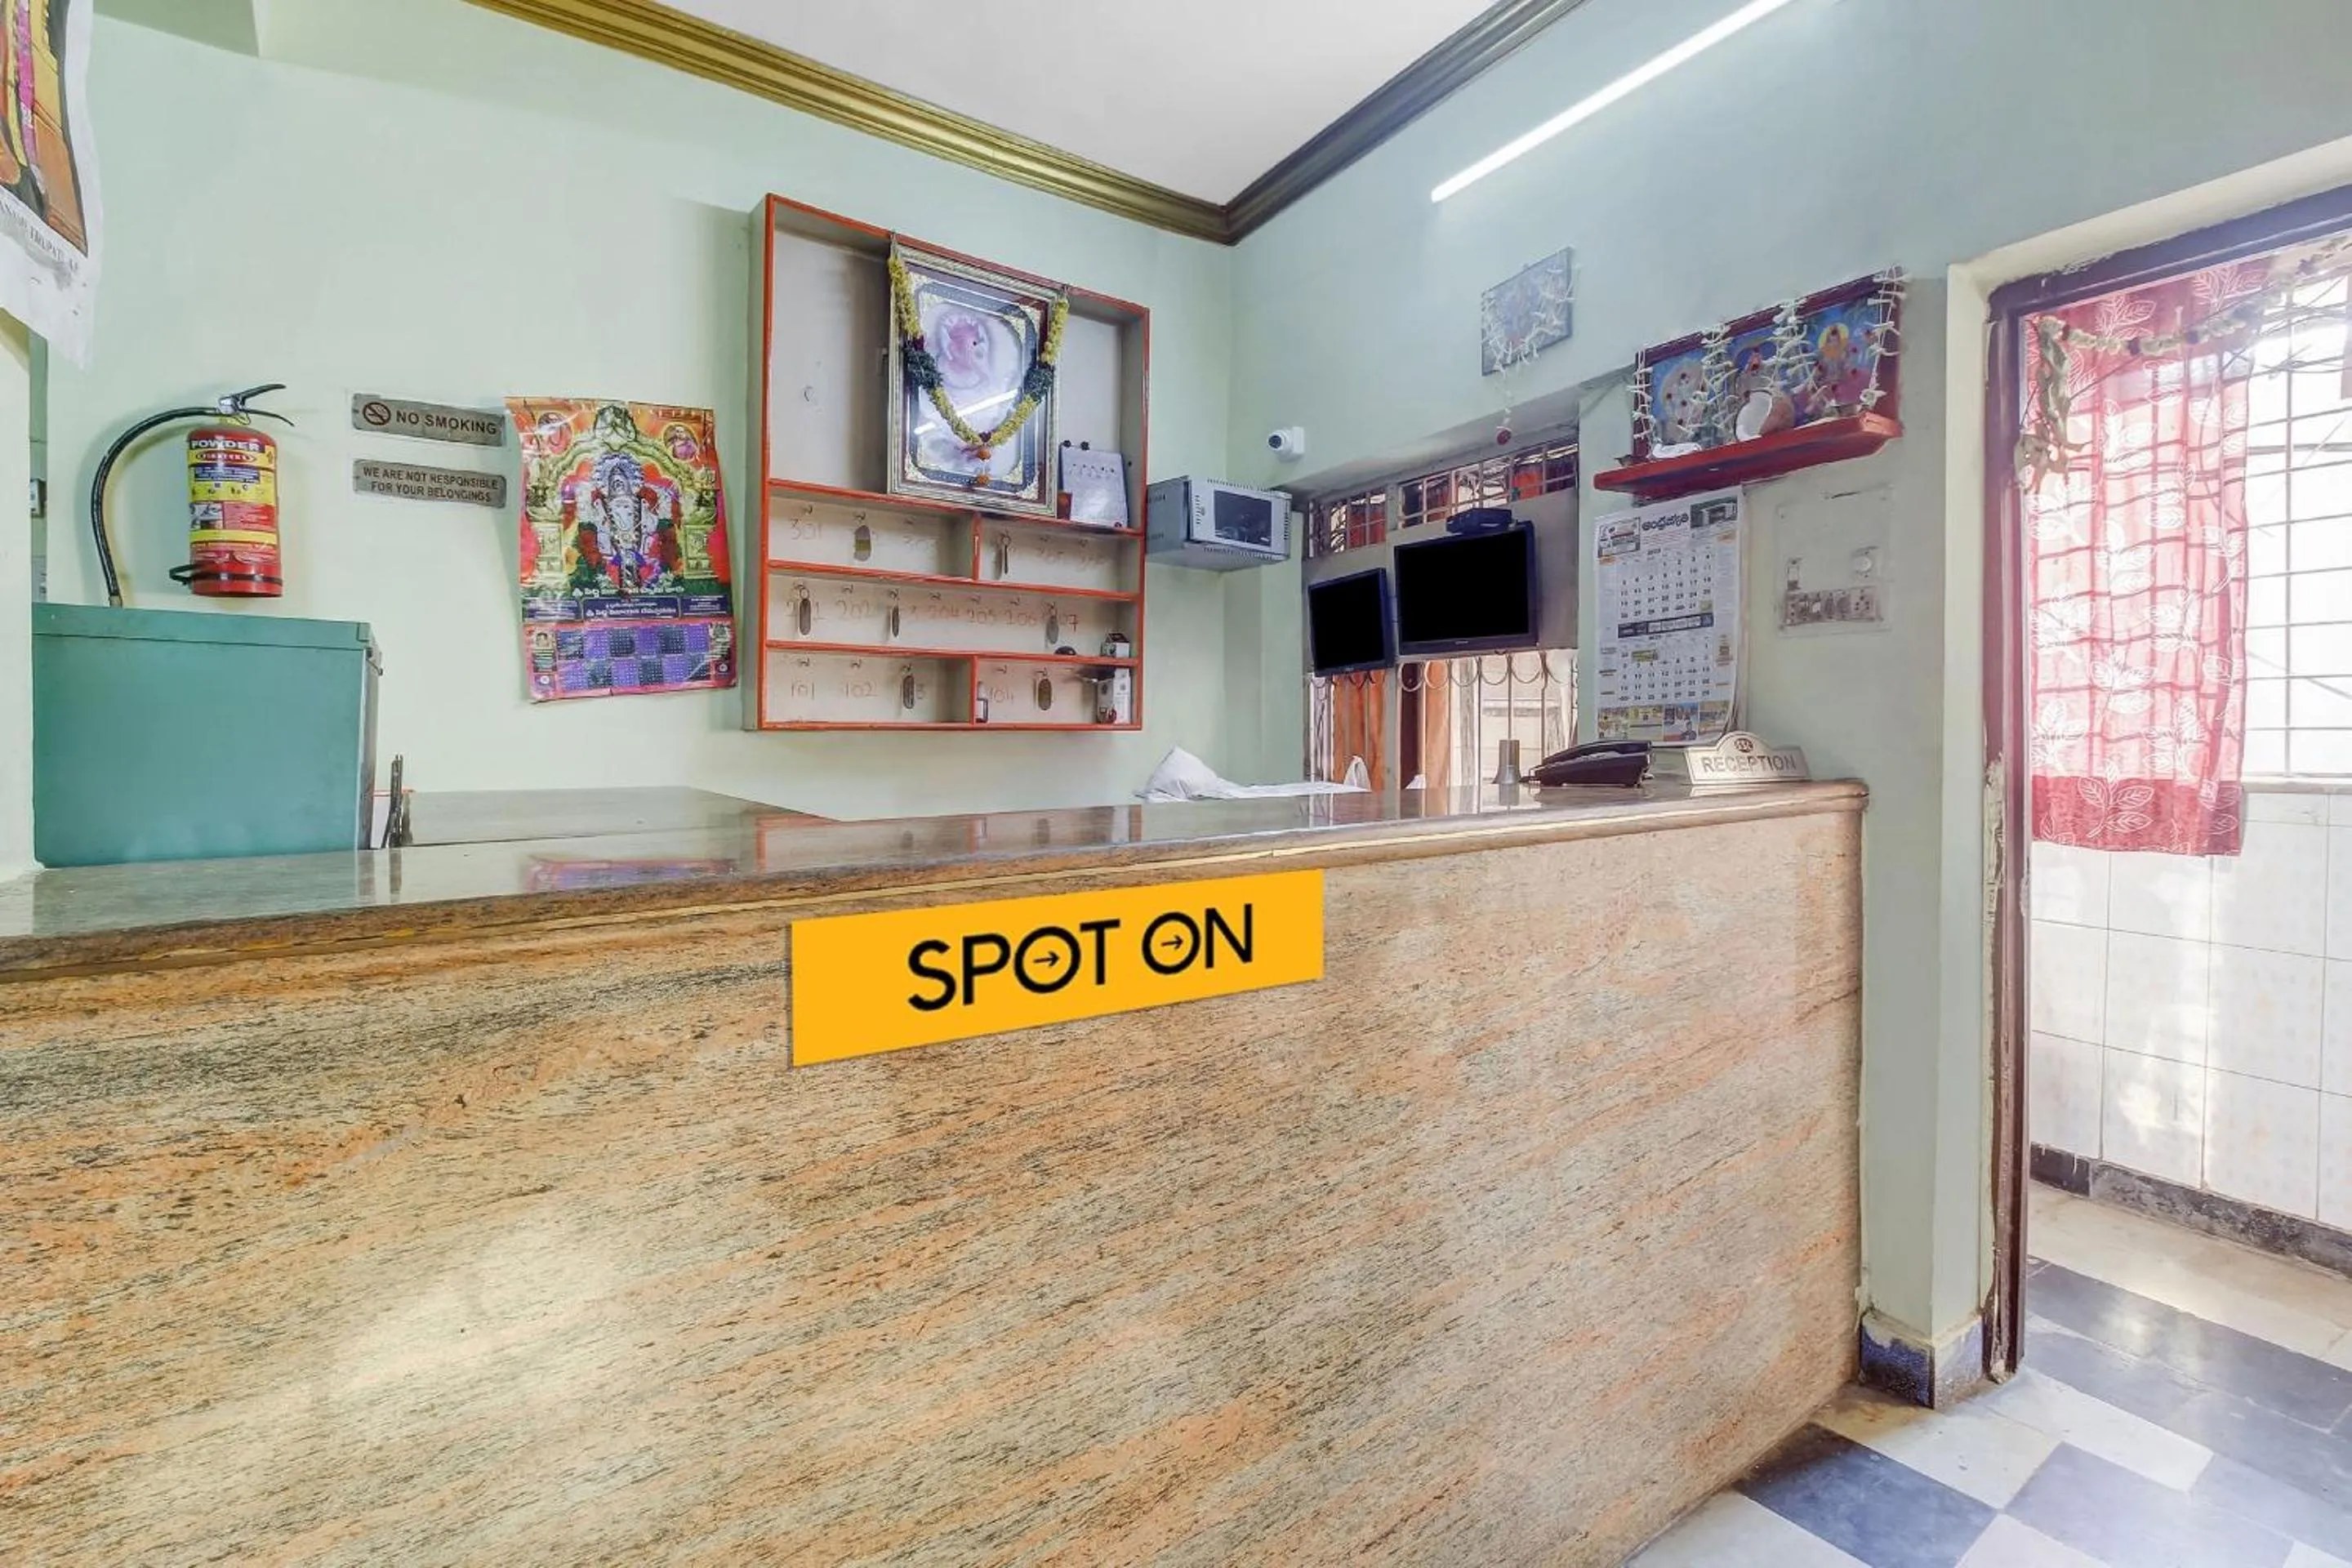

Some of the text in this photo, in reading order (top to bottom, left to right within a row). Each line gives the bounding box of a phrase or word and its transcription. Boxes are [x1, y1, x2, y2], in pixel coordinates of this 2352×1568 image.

[396, 411, 497, 435] NO SMOKING
[191, 439, 261, 452] POWDER
[363, 466, 499, 489] WE ARE NOT RESPONSIBLE
[371, 481, 491, 503] FOR YOUR BELONGINGS
[791, 679, 815, 700] 101
[845, 680, 879, 697] 102
[1700, 755, 1797, 773] RECEPTION
[907, 902, 1254, 1012] SPOT ON
